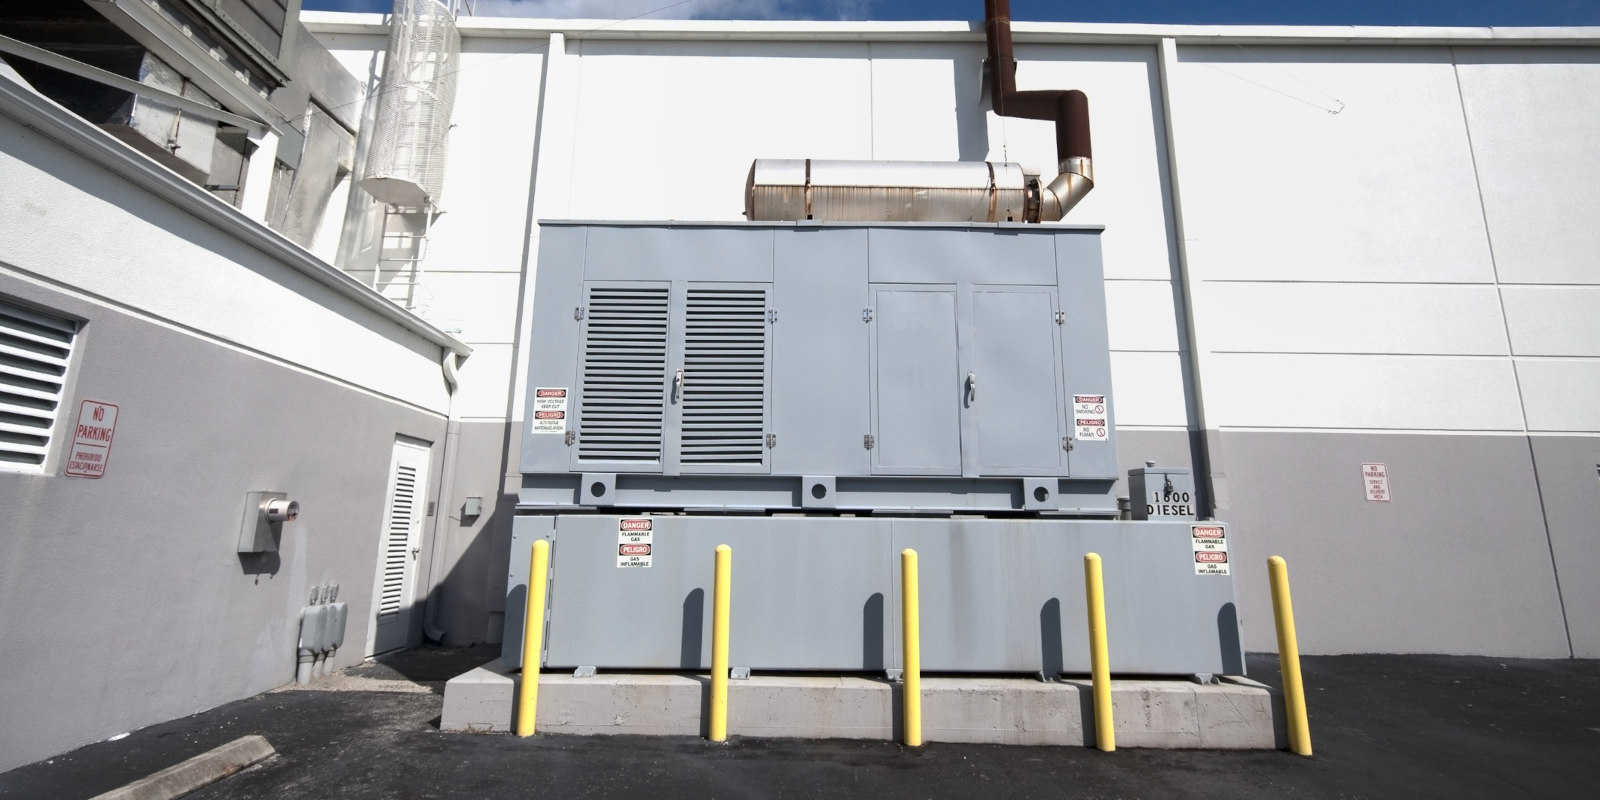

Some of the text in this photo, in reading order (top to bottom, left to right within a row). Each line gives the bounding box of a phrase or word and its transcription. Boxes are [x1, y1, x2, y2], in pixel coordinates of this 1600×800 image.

[93, 407, 104, 421] NO
[77, 424, 112, 442] PARKING
[76, 452, 102, 462] PROHIBIDO
[1154, 492, 1190, 502] 1600
[1146, 504, 1194, 516] DIESEL
